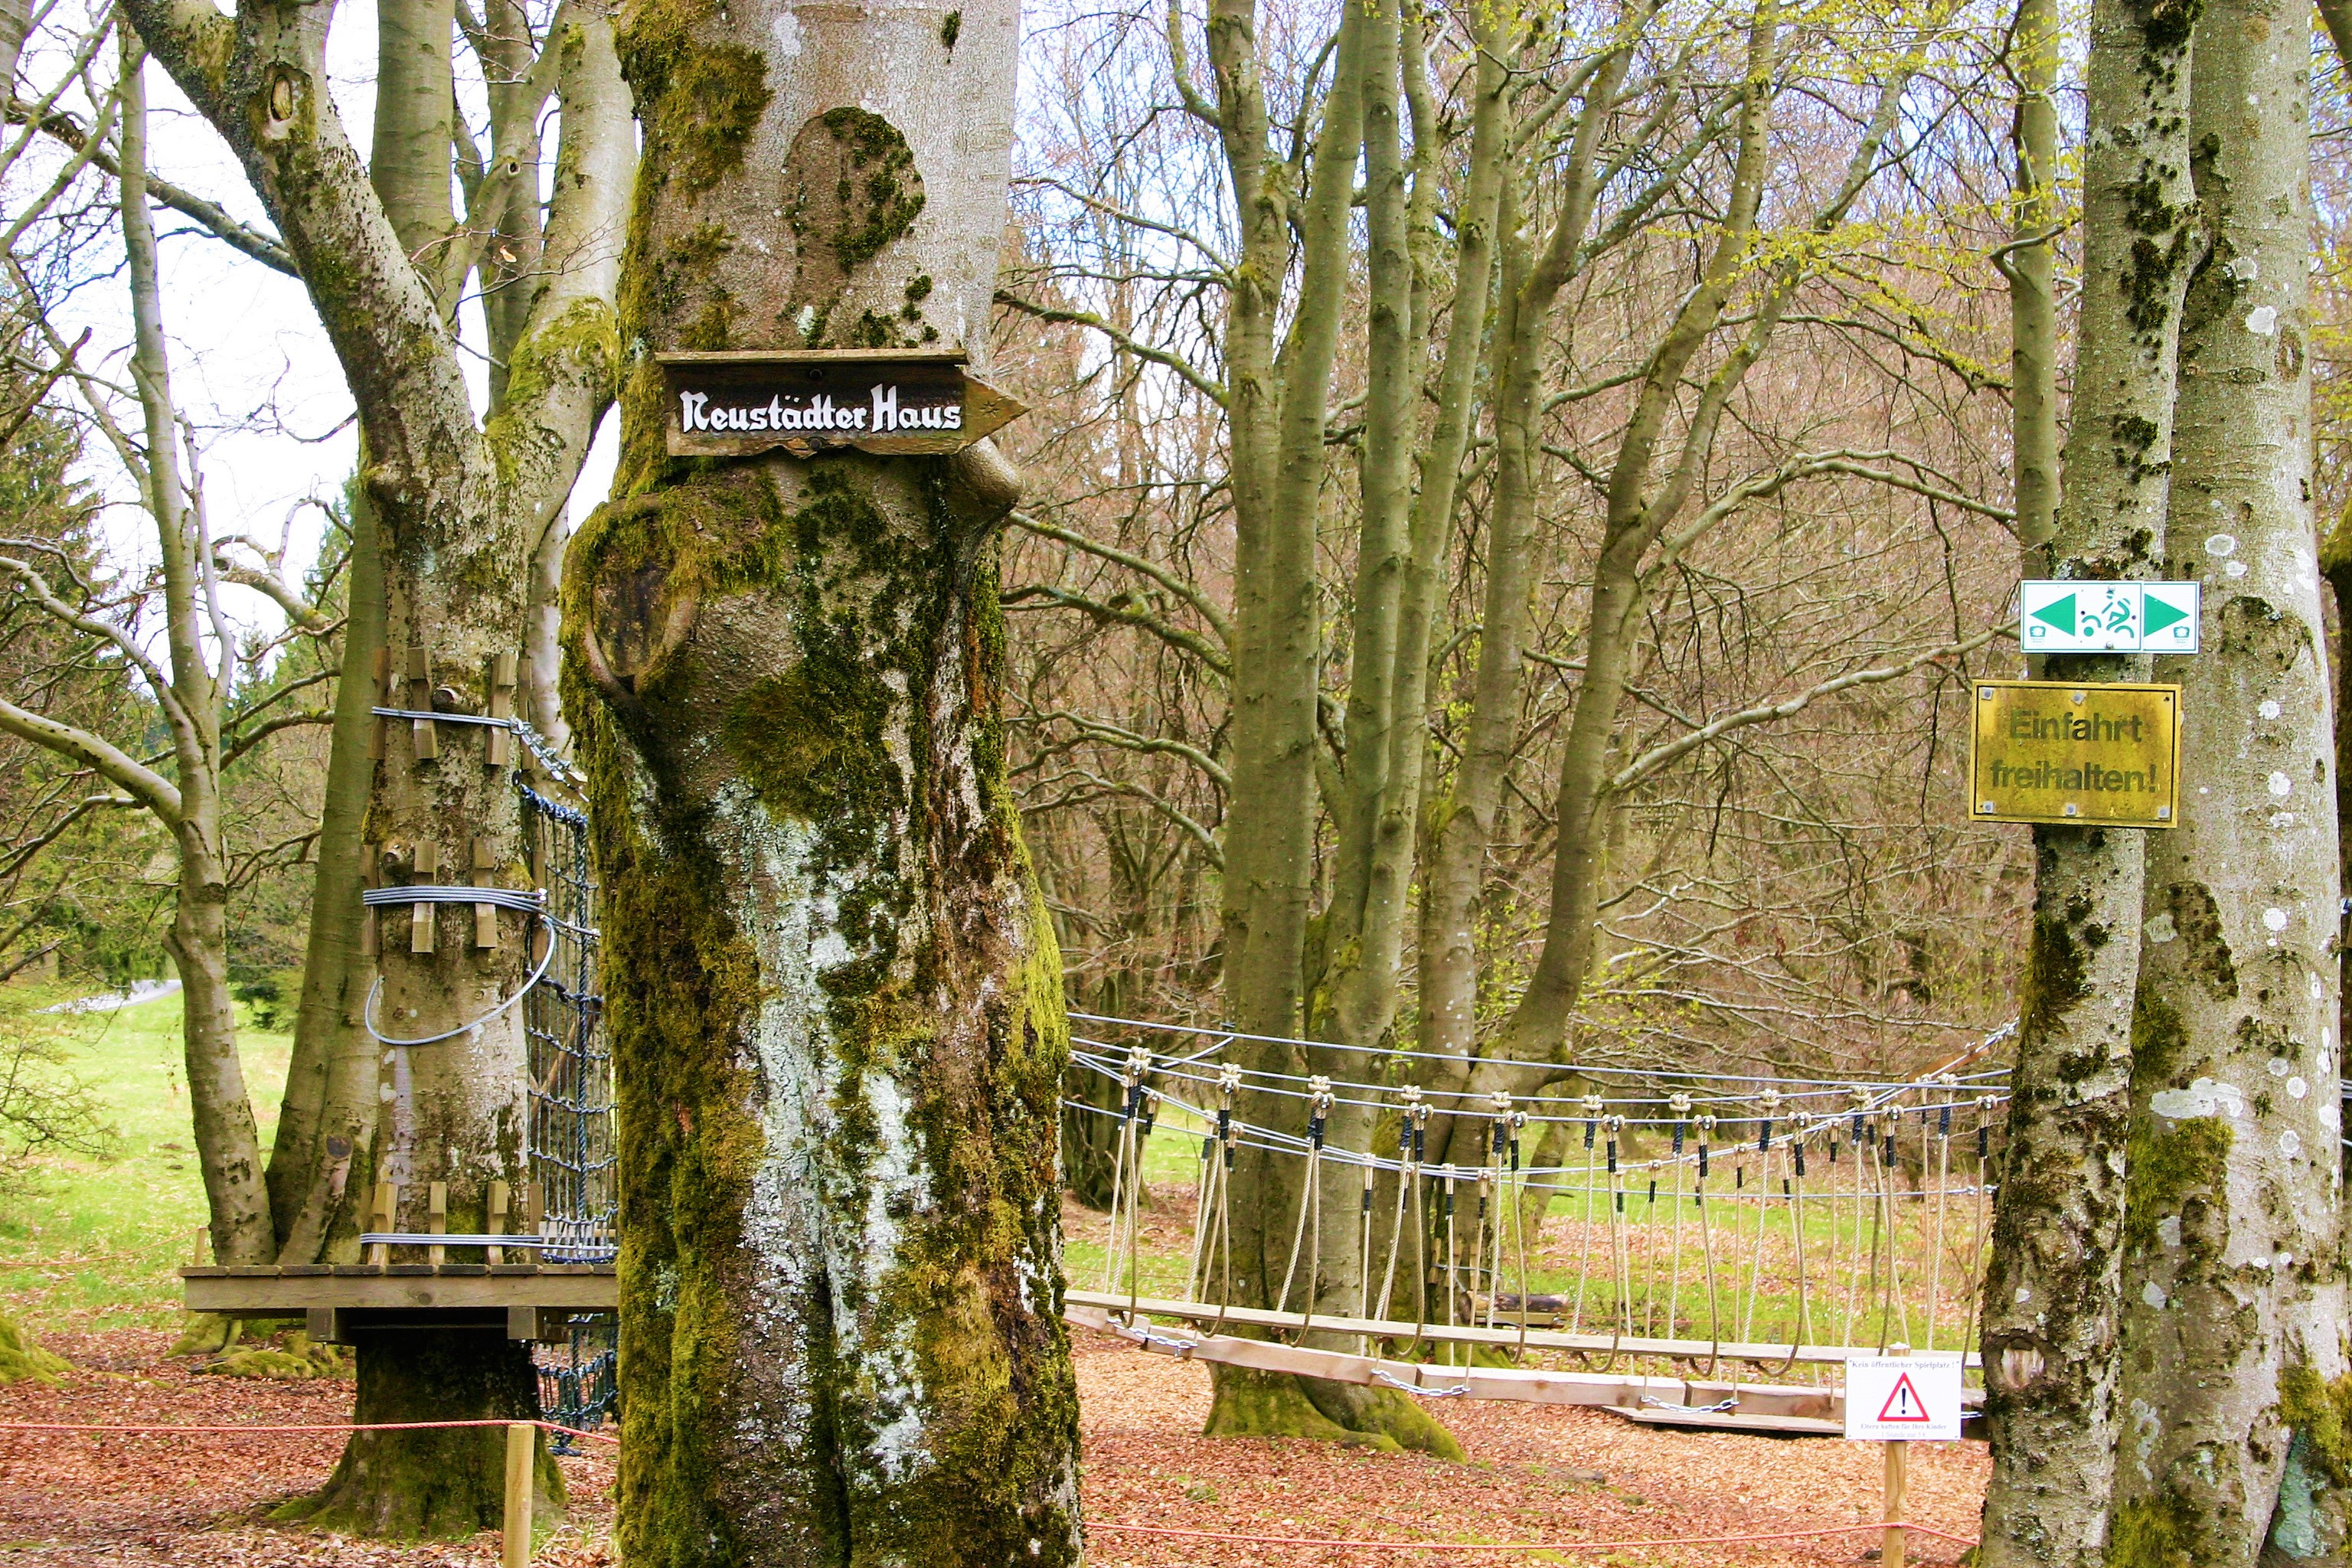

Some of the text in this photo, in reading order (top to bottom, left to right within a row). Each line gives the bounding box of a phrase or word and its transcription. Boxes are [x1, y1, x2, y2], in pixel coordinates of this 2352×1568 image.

[678, 383, 962, 433] Neustädter Haus
[2009, 709, 2143, 743] Einfahrt
[1990, 760, 2157, 793] freihalten!
[1915, 1361, 1950, 1370] Spielplatz
